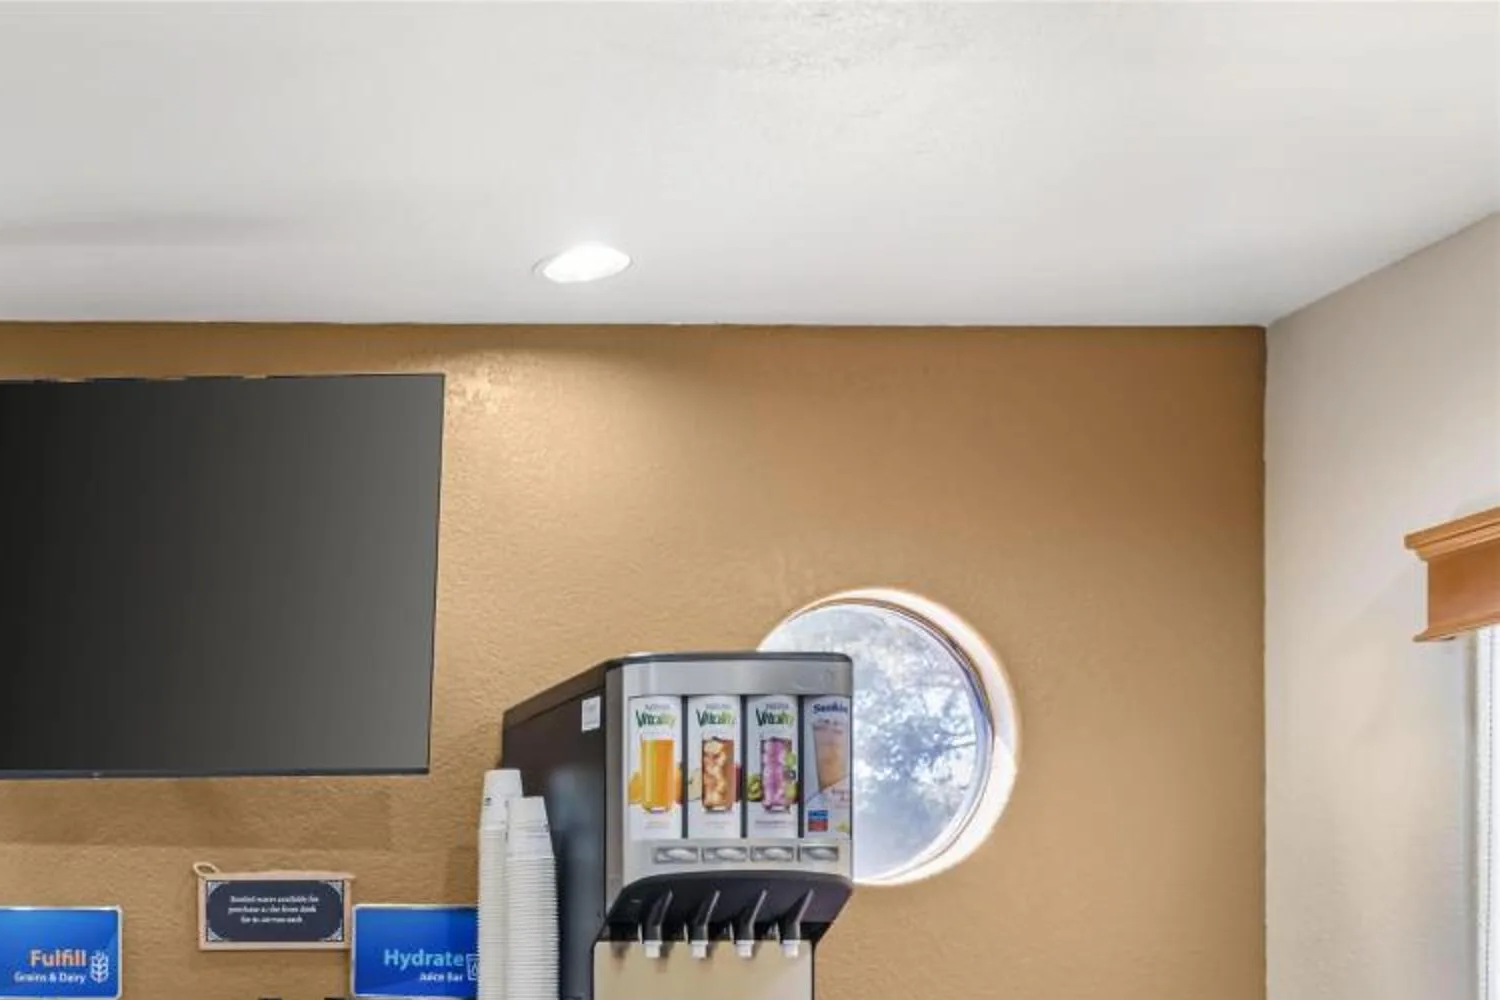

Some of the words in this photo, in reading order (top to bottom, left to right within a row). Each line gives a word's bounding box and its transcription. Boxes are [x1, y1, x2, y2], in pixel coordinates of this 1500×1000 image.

[29, 948, 87, 968] Fulfill
[383, 948, 465, 971] Hydrate
[59, 972, 87, 985] Dairy
